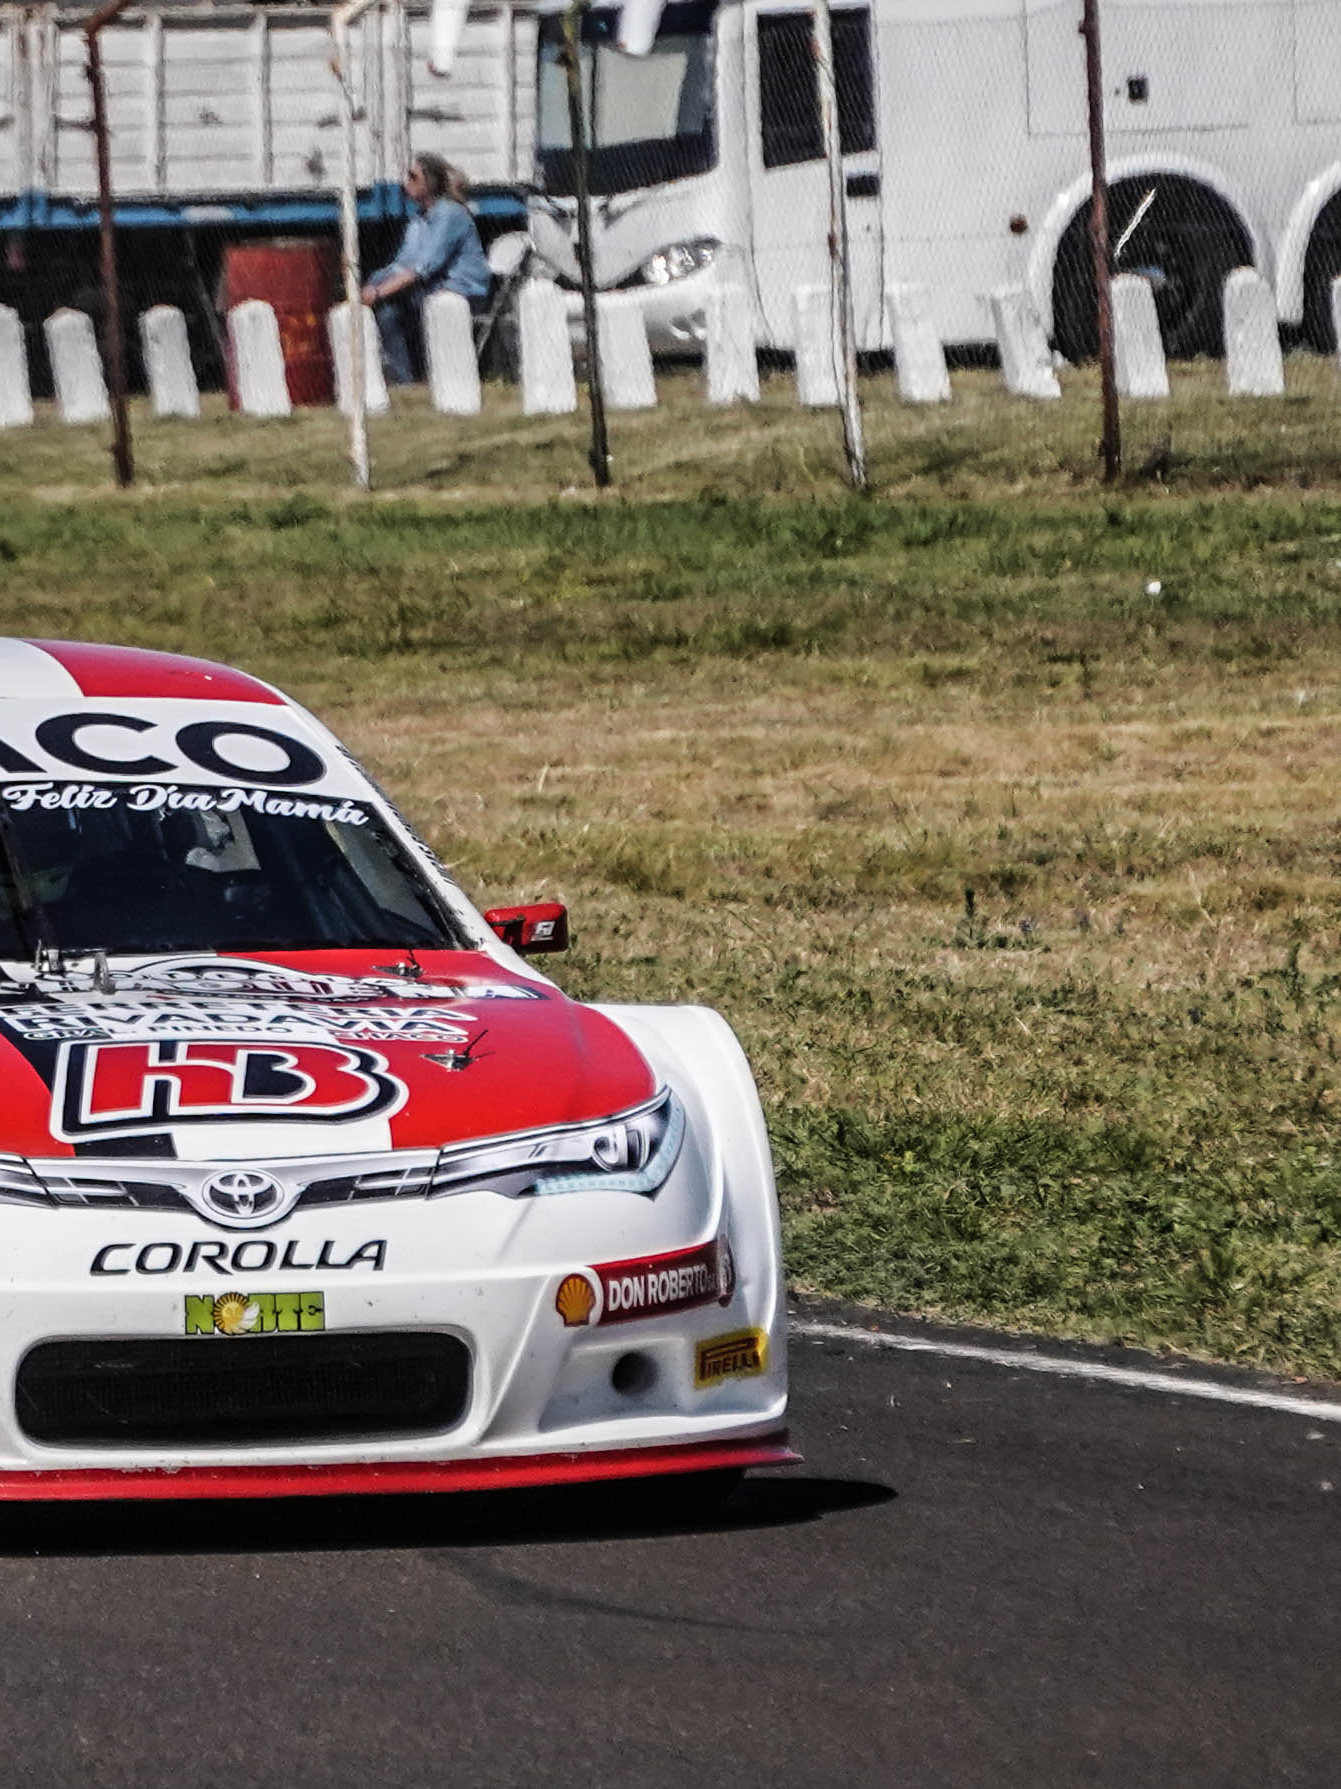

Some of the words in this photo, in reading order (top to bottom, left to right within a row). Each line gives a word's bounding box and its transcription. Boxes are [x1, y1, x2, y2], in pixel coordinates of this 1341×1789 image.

[2, 782, 118, 811] Feliz
[15, 1013, 457, 1034] RIVADAVIA
[148, 1025, 292, 1034] PINEDO
[89, 1239, 388, 1276] COROLLA
[608, 1274, 645, 1312] DON
[648, 1263, 707, 1305] ROBERTO
